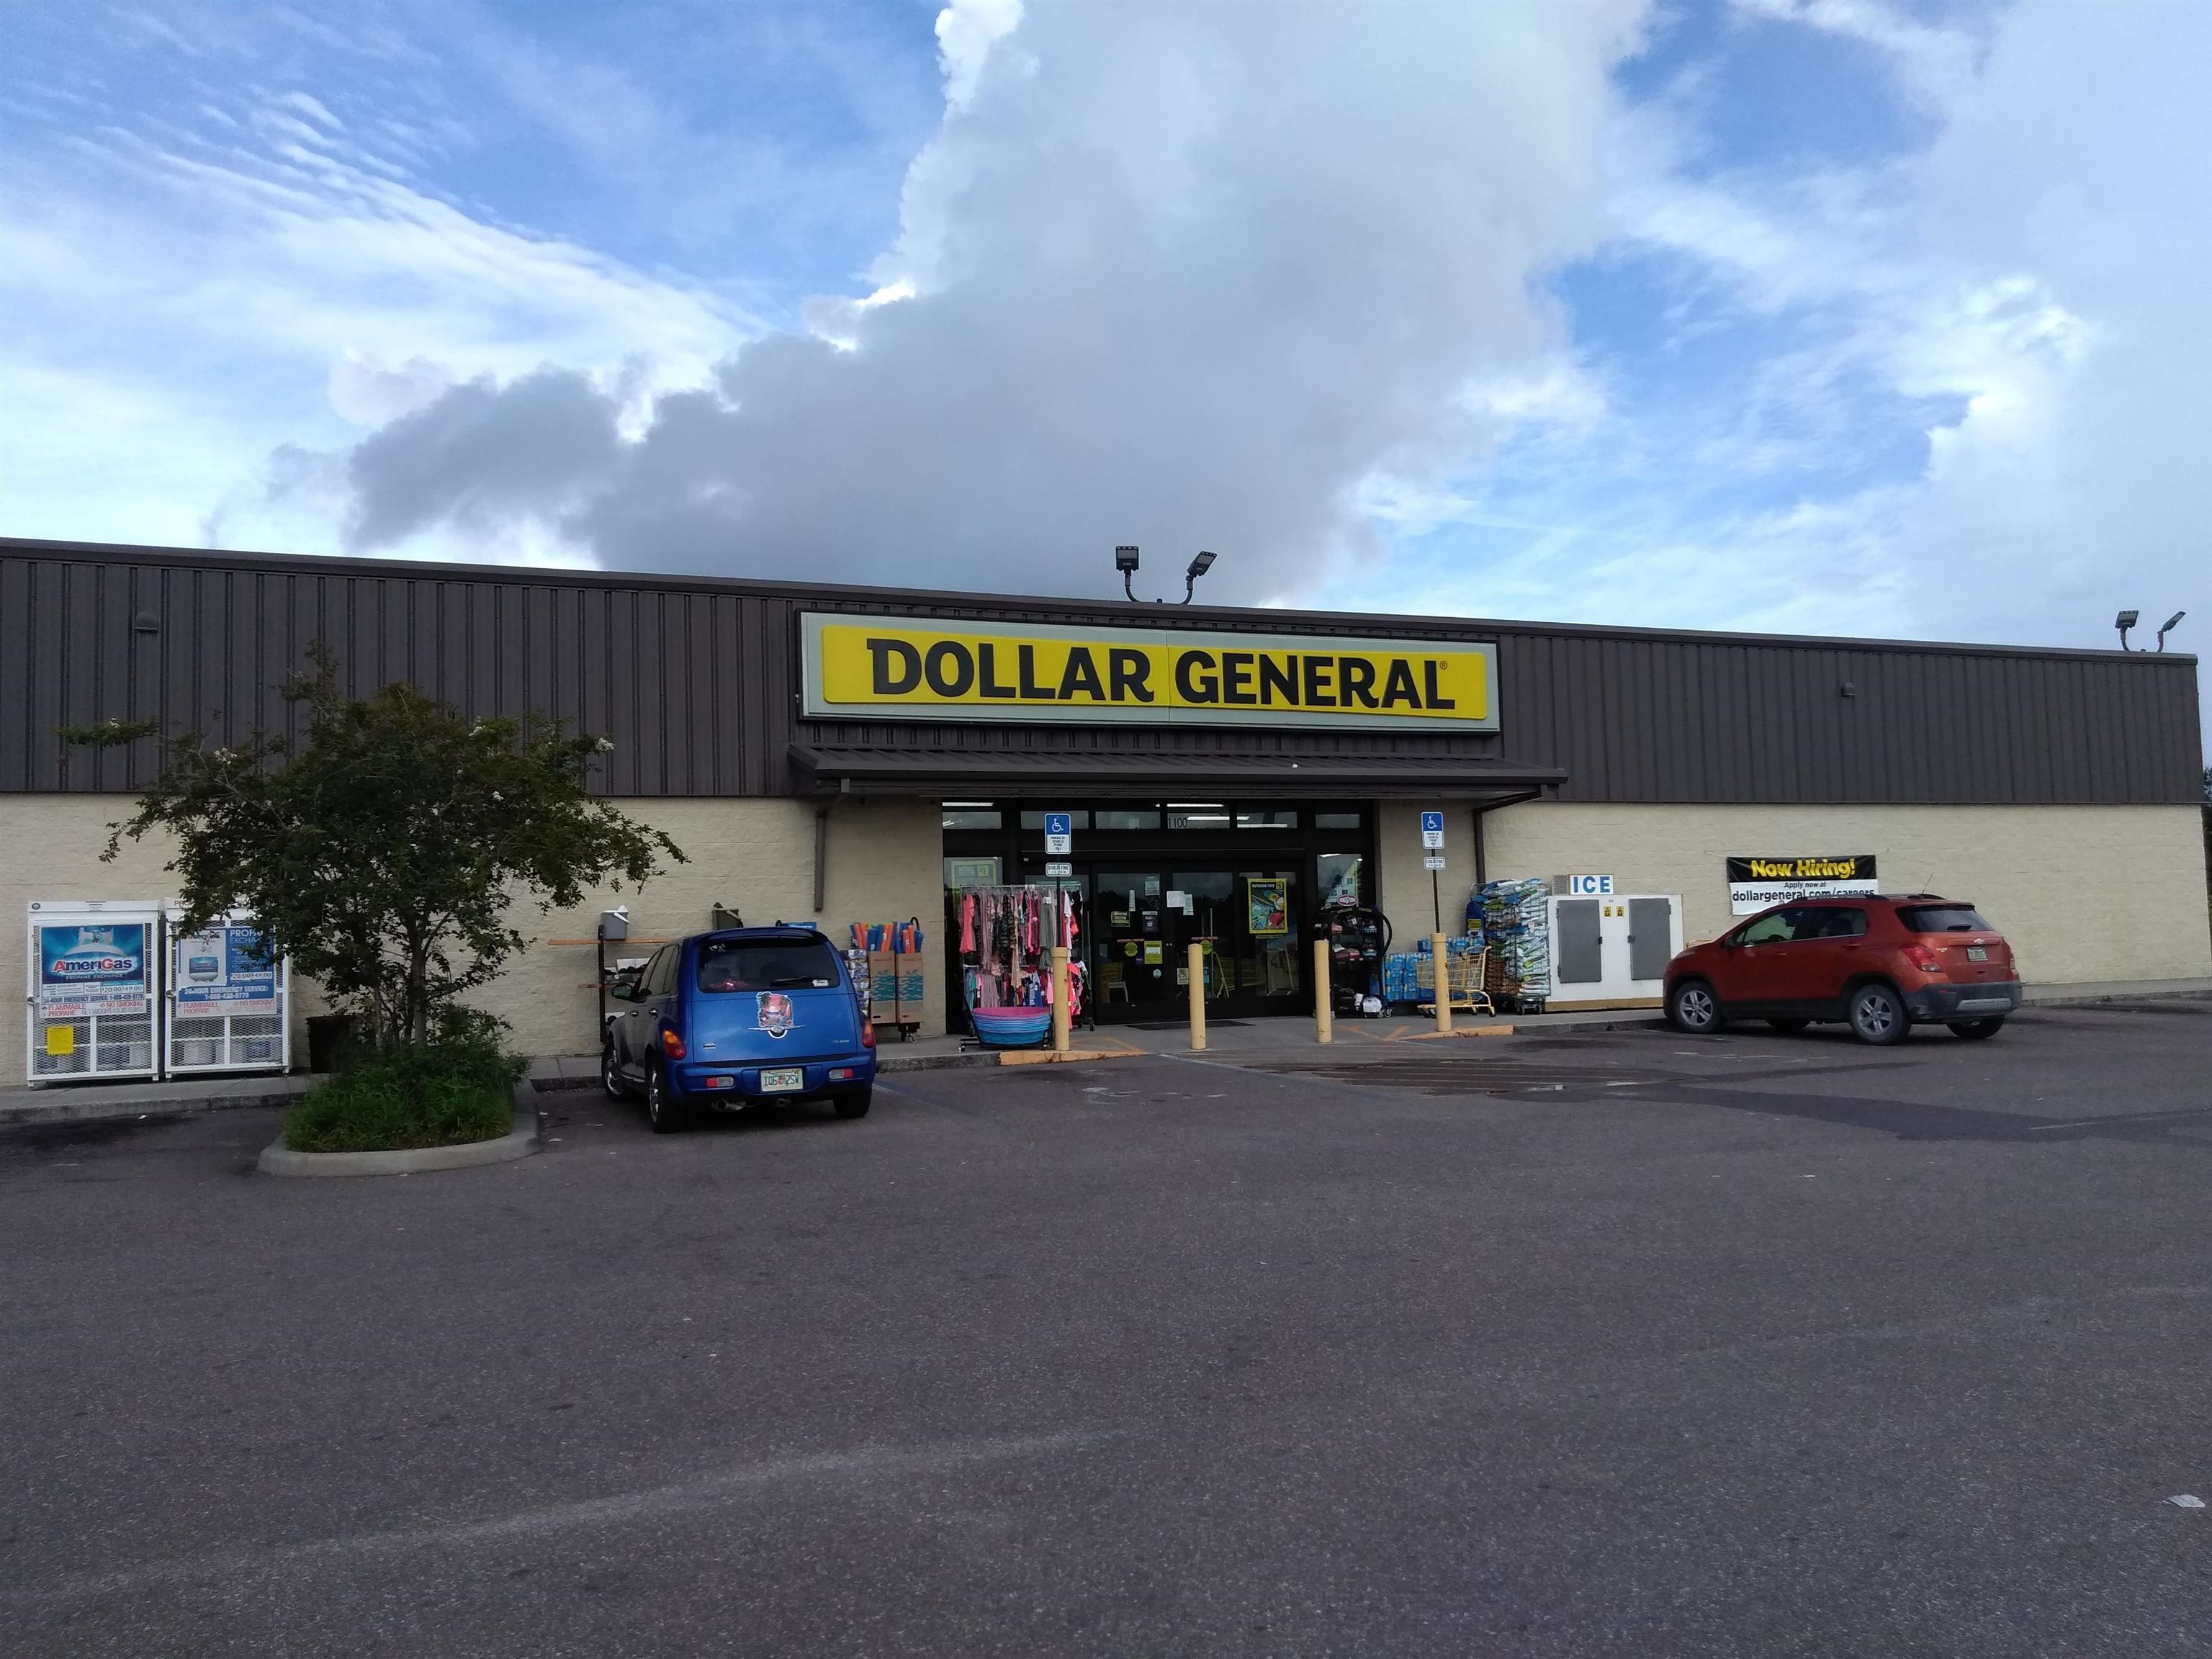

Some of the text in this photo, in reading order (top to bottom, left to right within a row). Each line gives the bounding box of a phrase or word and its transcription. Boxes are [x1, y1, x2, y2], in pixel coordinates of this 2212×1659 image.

[866, 638, 1455, 709] DOLLAR GENERAL
[1168, 817, 1187, 828] 1100
[1751, 858, 1855, 878] Now Hiring!
[1573, 876, 1611, 894] ICE
[1732, 888, 1875, 902] dollargeneralcom/careers
[53, 958, 132, 972] AmeriGas
